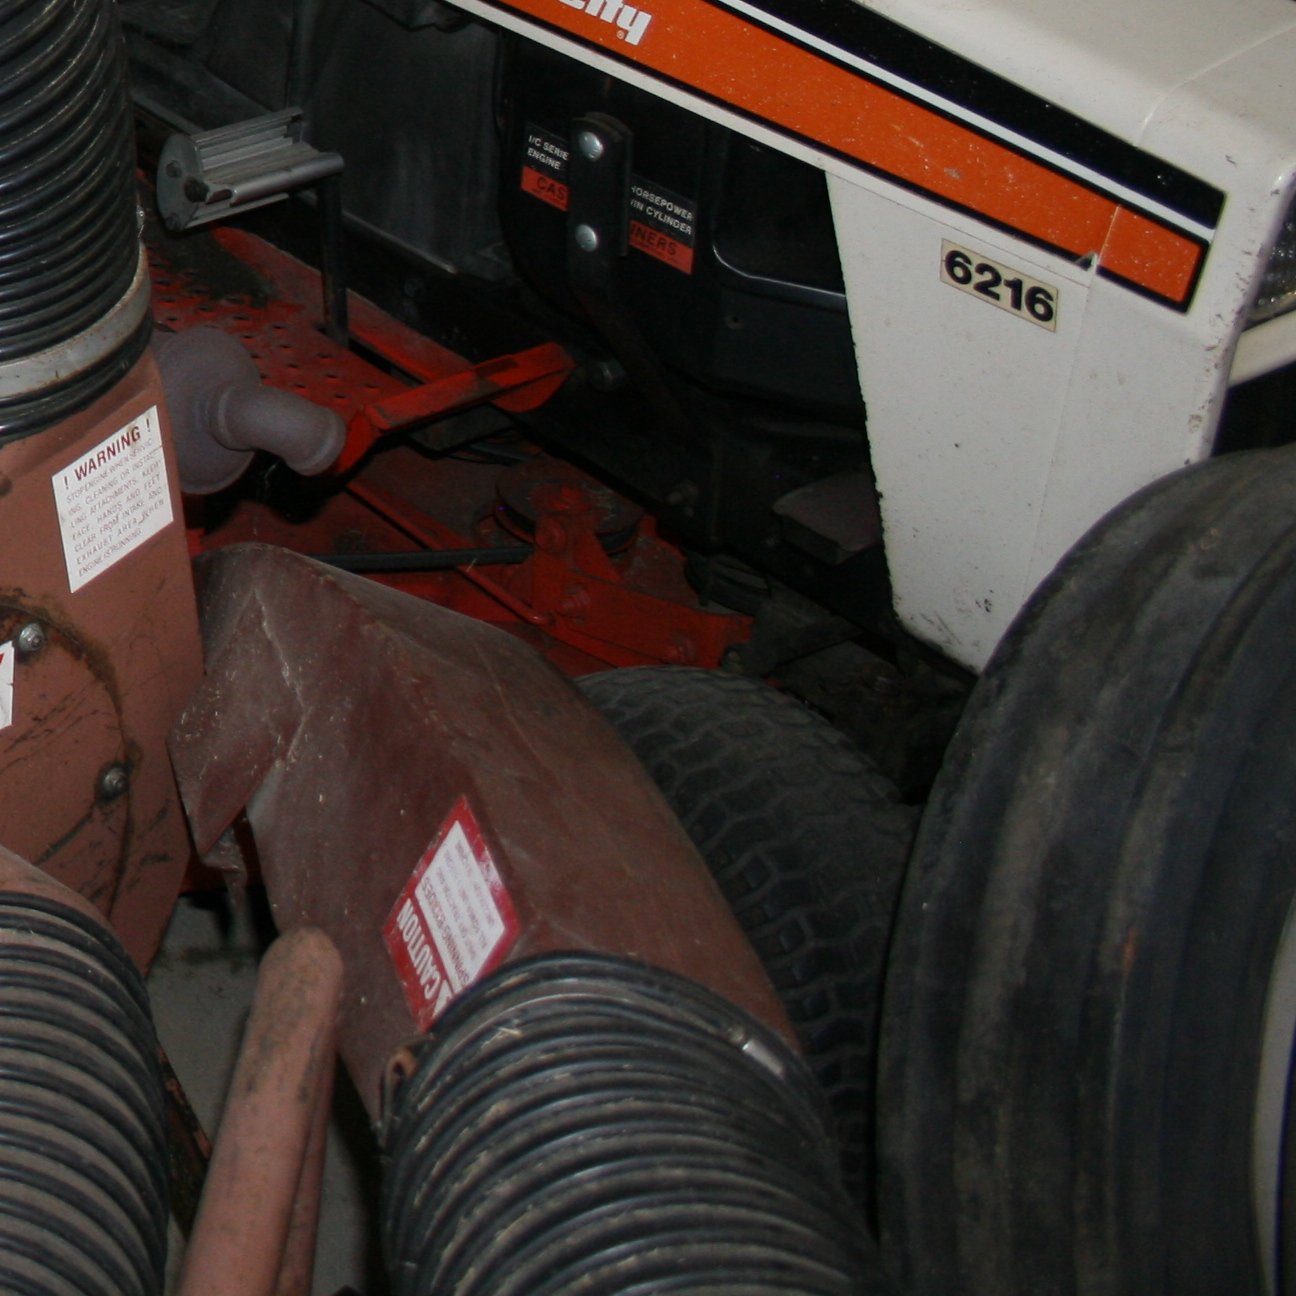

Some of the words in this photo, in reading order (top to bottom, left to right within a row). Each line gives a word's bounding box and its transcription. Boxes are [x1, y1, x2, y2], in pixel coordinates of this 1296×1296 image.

[543, 142, 569, 160] SERIE
[527, 147, 561, 170] ENGINE
[646, 206, 692, 235] CYLINDER
[945, 250, 1054, 322] 6216
[74, 426, 141, 481] WARNING
[397, 898, 441, 1000] CAUTION
